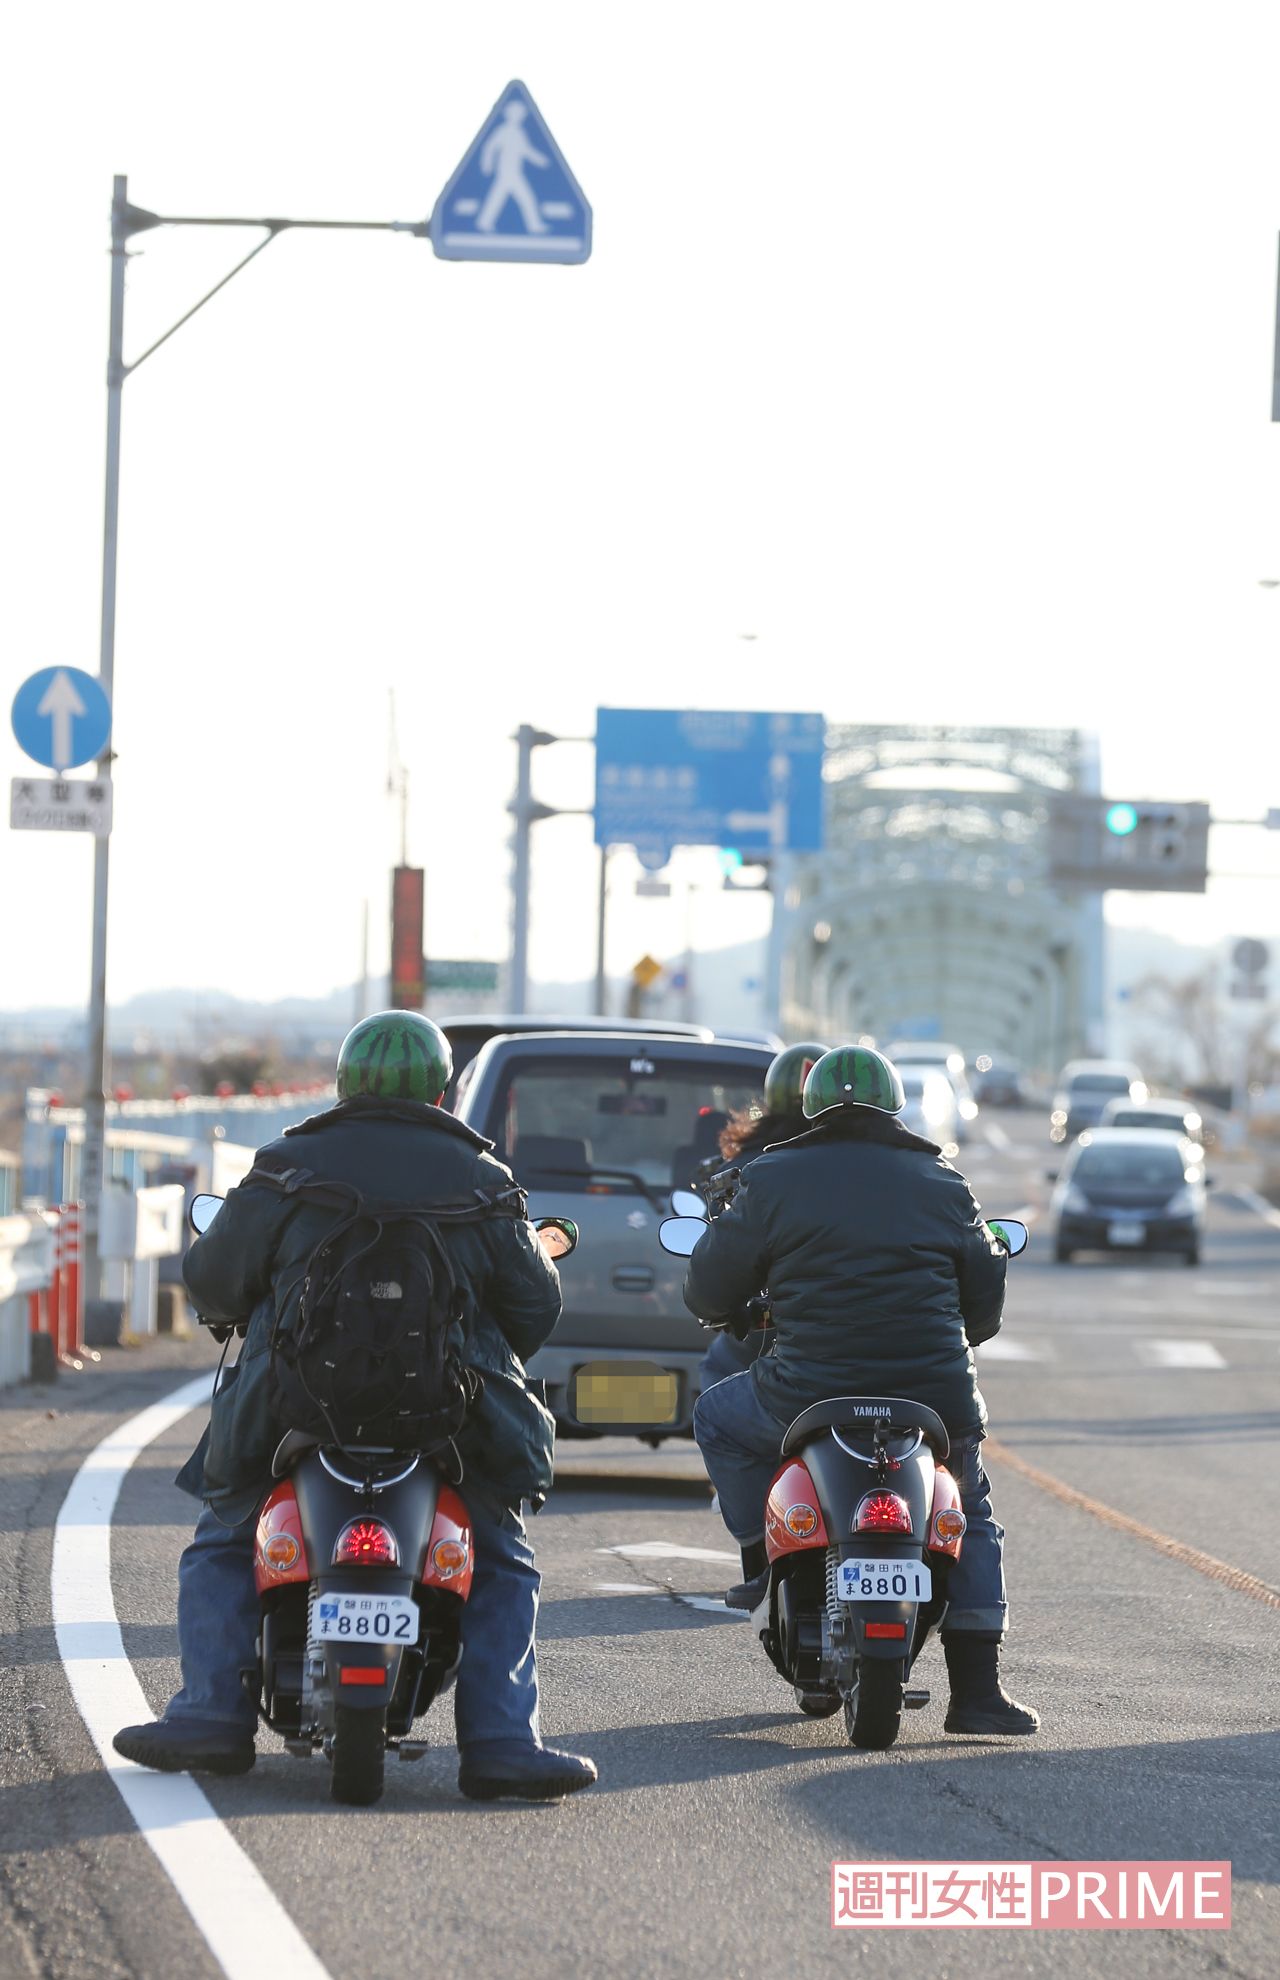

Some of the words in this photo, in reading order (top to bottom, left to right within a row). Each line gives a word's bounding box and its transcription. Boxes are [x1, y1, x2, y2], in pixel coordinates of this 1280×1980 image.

[853, 1406, 892, 1417] YAMAHA
[845, 1582, 856, 1596] ま
[861, 1574, 920, 1597] 8801
[321, 1620, 332, 1635] ま
[337, 1613, 411, 1639] 8802
